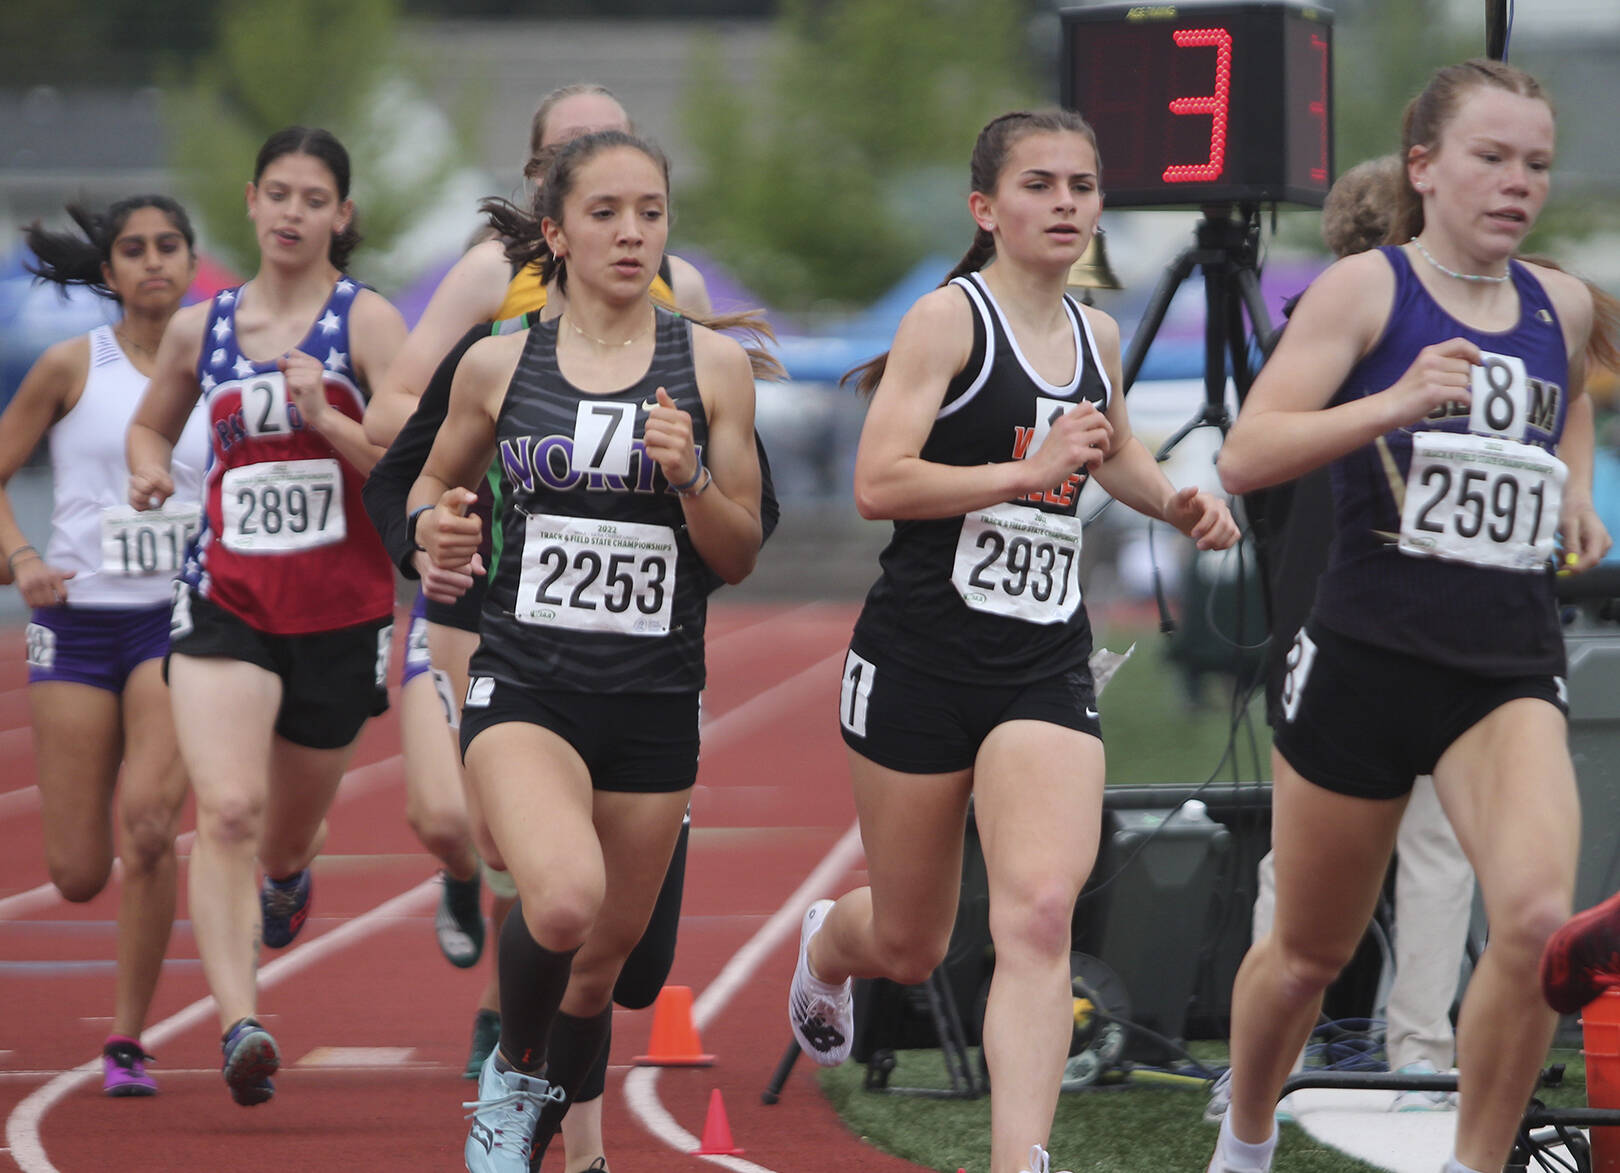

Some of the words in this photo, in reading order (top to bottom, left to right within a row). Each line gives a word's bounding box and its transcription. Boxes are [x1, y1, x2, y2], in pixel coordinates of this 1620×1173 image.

[1162, 28, 1232, 183] 3
[252, 381, 280, 433] 2
[1485, 357, 1514, 431] 8
[589, 406, 624, 468] 7
[237, 483, 334, 535] 2897
[598, 524, 617, 534] 2022
[1415, 464, 1545, 547] 2591
[540, 531, 563, 541] TRACK
[570, 535, 590, 545] FIELD
[591, 537, 612, 547] STATE
[612, 540, 672, 551] CHAMPIONSHIPS
[968, 530, 1075, 606] 2937
[535, 545, 667, 615] 2253
[846, 661, 863, 727] 1
